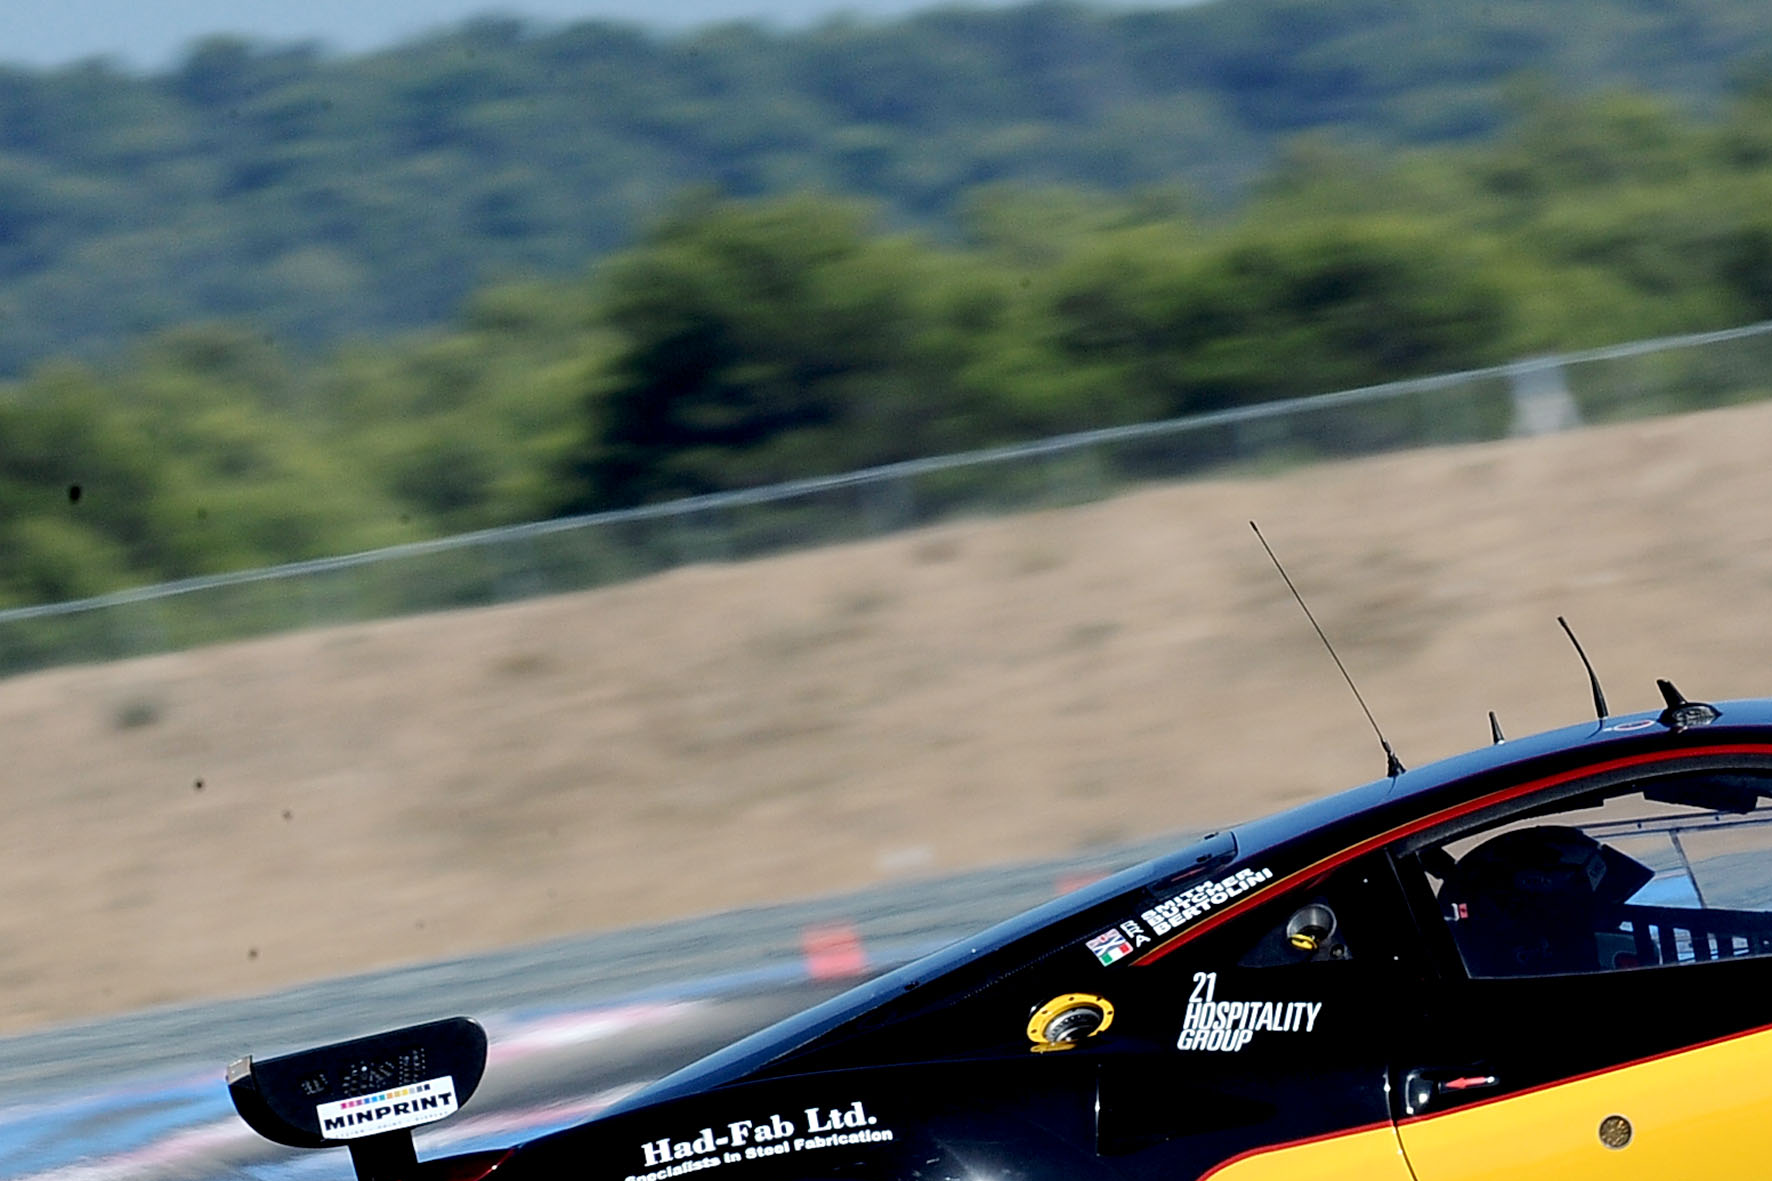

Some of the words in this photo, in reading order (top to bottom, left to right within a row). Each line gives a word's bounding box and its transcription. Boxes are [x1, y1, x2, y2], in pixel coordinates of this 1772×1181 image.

[1136, 934, 1151, 948] A
[1152, 868, 1273, 936] BERTOLINI
[1141, 881, 1214, 921] SMITH
[1146, 868, 1255, 927] BUTCHER
[1189, 972, 1217, 1002] 21
[1183, 1001, 1322, 1032] HOSPITALITY
[1177, 1029, 1253, 1052] GROUP
[324, 1092, 452, 1131] MINPRINT
[641, 1114, 795, 1167] Had-Fab
[804, 1101, 878, 1133] Ltd.
[745, 1140, 790, 1159] Steel
[794, 1128, 893, 1151] Fabrication
